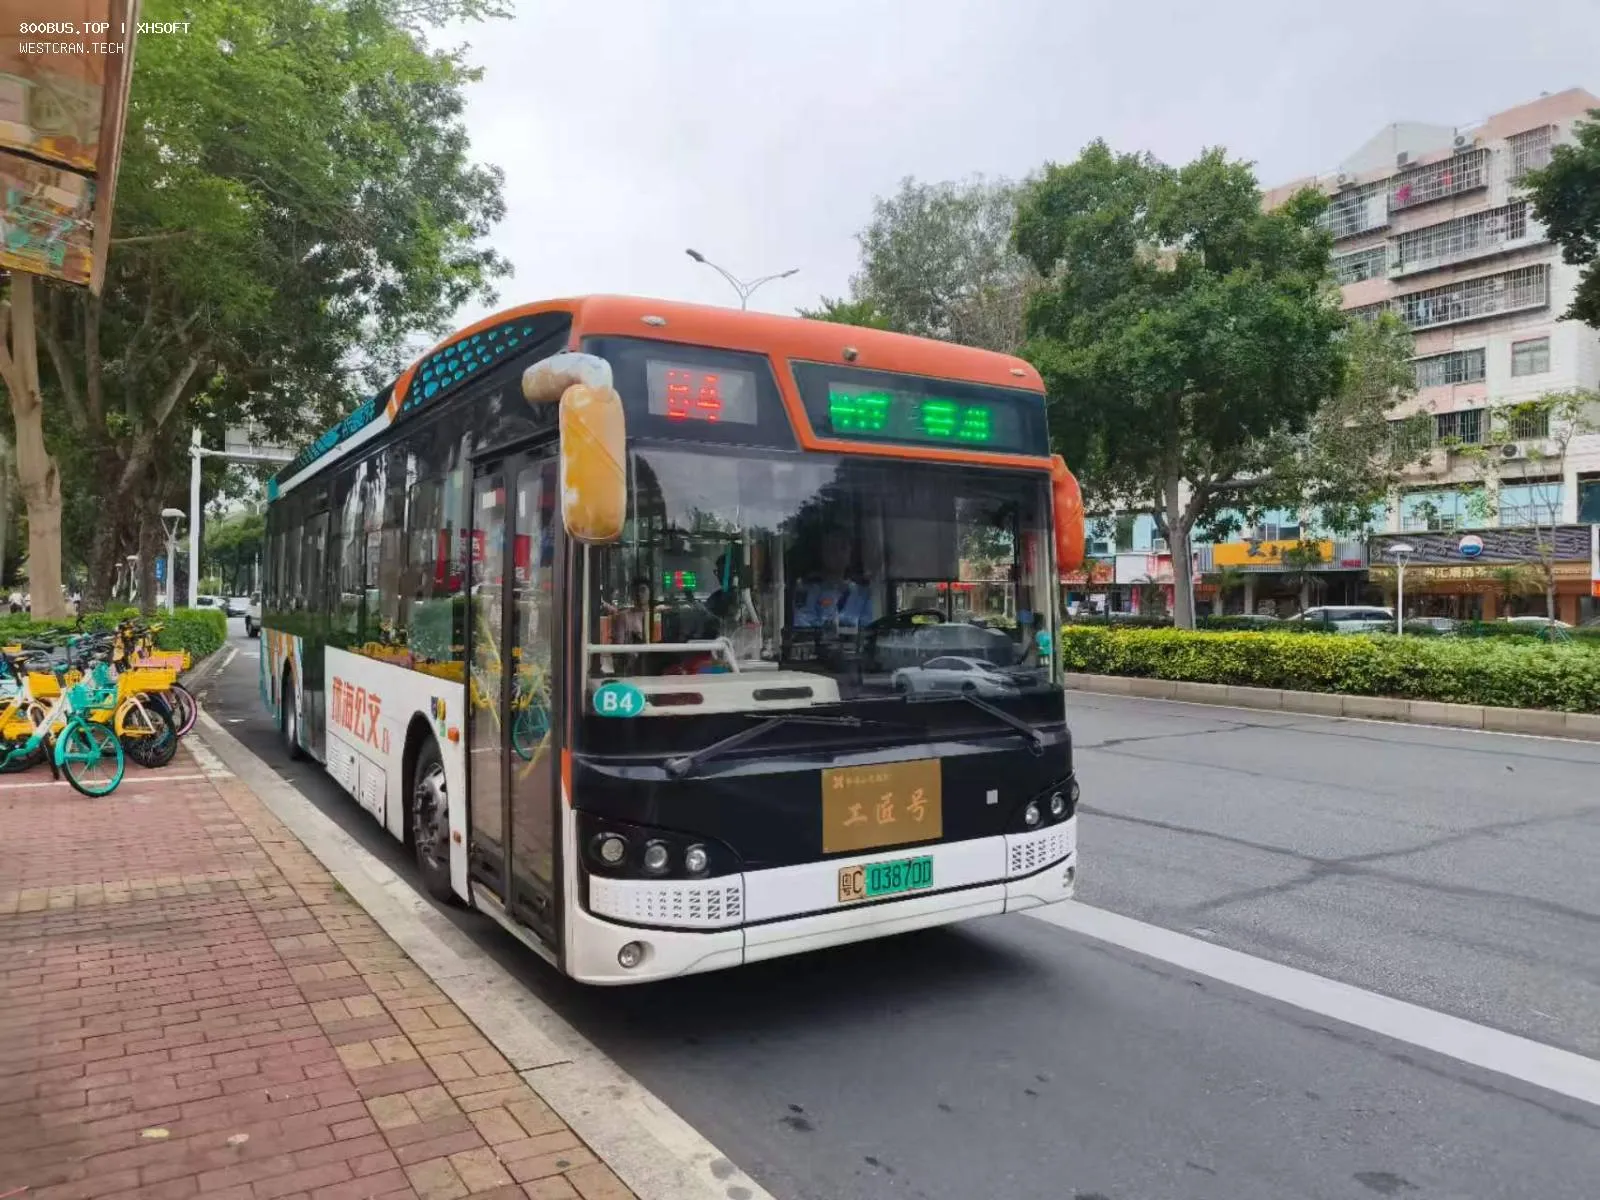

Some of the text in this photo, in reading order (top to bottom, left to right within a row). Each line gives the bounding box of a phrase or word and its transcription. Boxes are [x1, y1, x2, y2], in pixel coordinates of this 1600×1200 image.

[602, 691, 633, 712] B4
[843, 788, 928, 827] 工匠号
